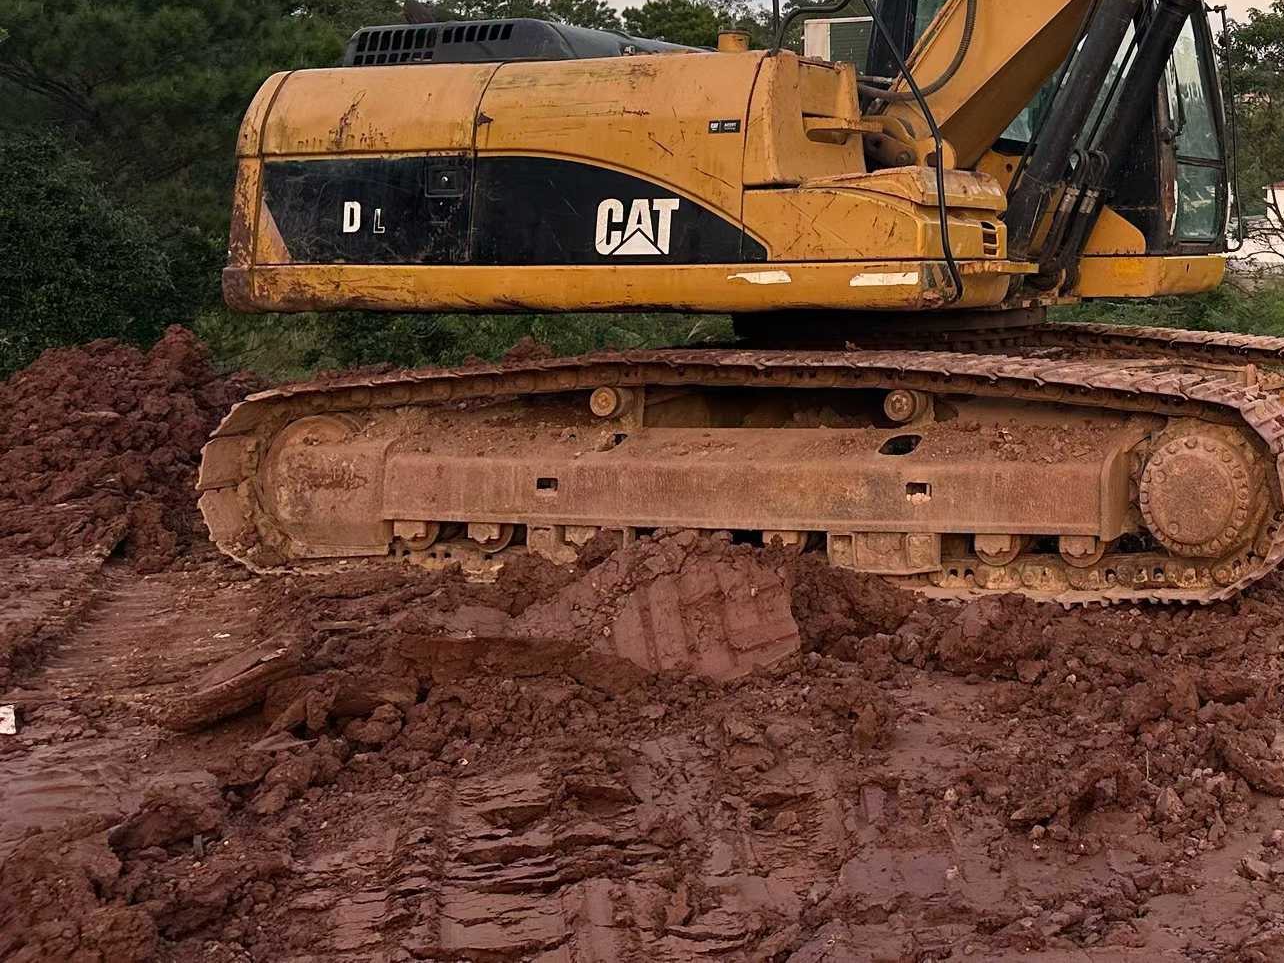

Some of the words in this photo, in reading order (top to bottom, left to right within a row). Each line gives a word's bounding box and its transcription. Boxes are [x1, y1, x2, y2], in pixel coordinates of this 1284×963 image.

[342, 201, 362, 233] D
[372, 208, 386, 234] L
[595, 198, 680, 256] CAT
